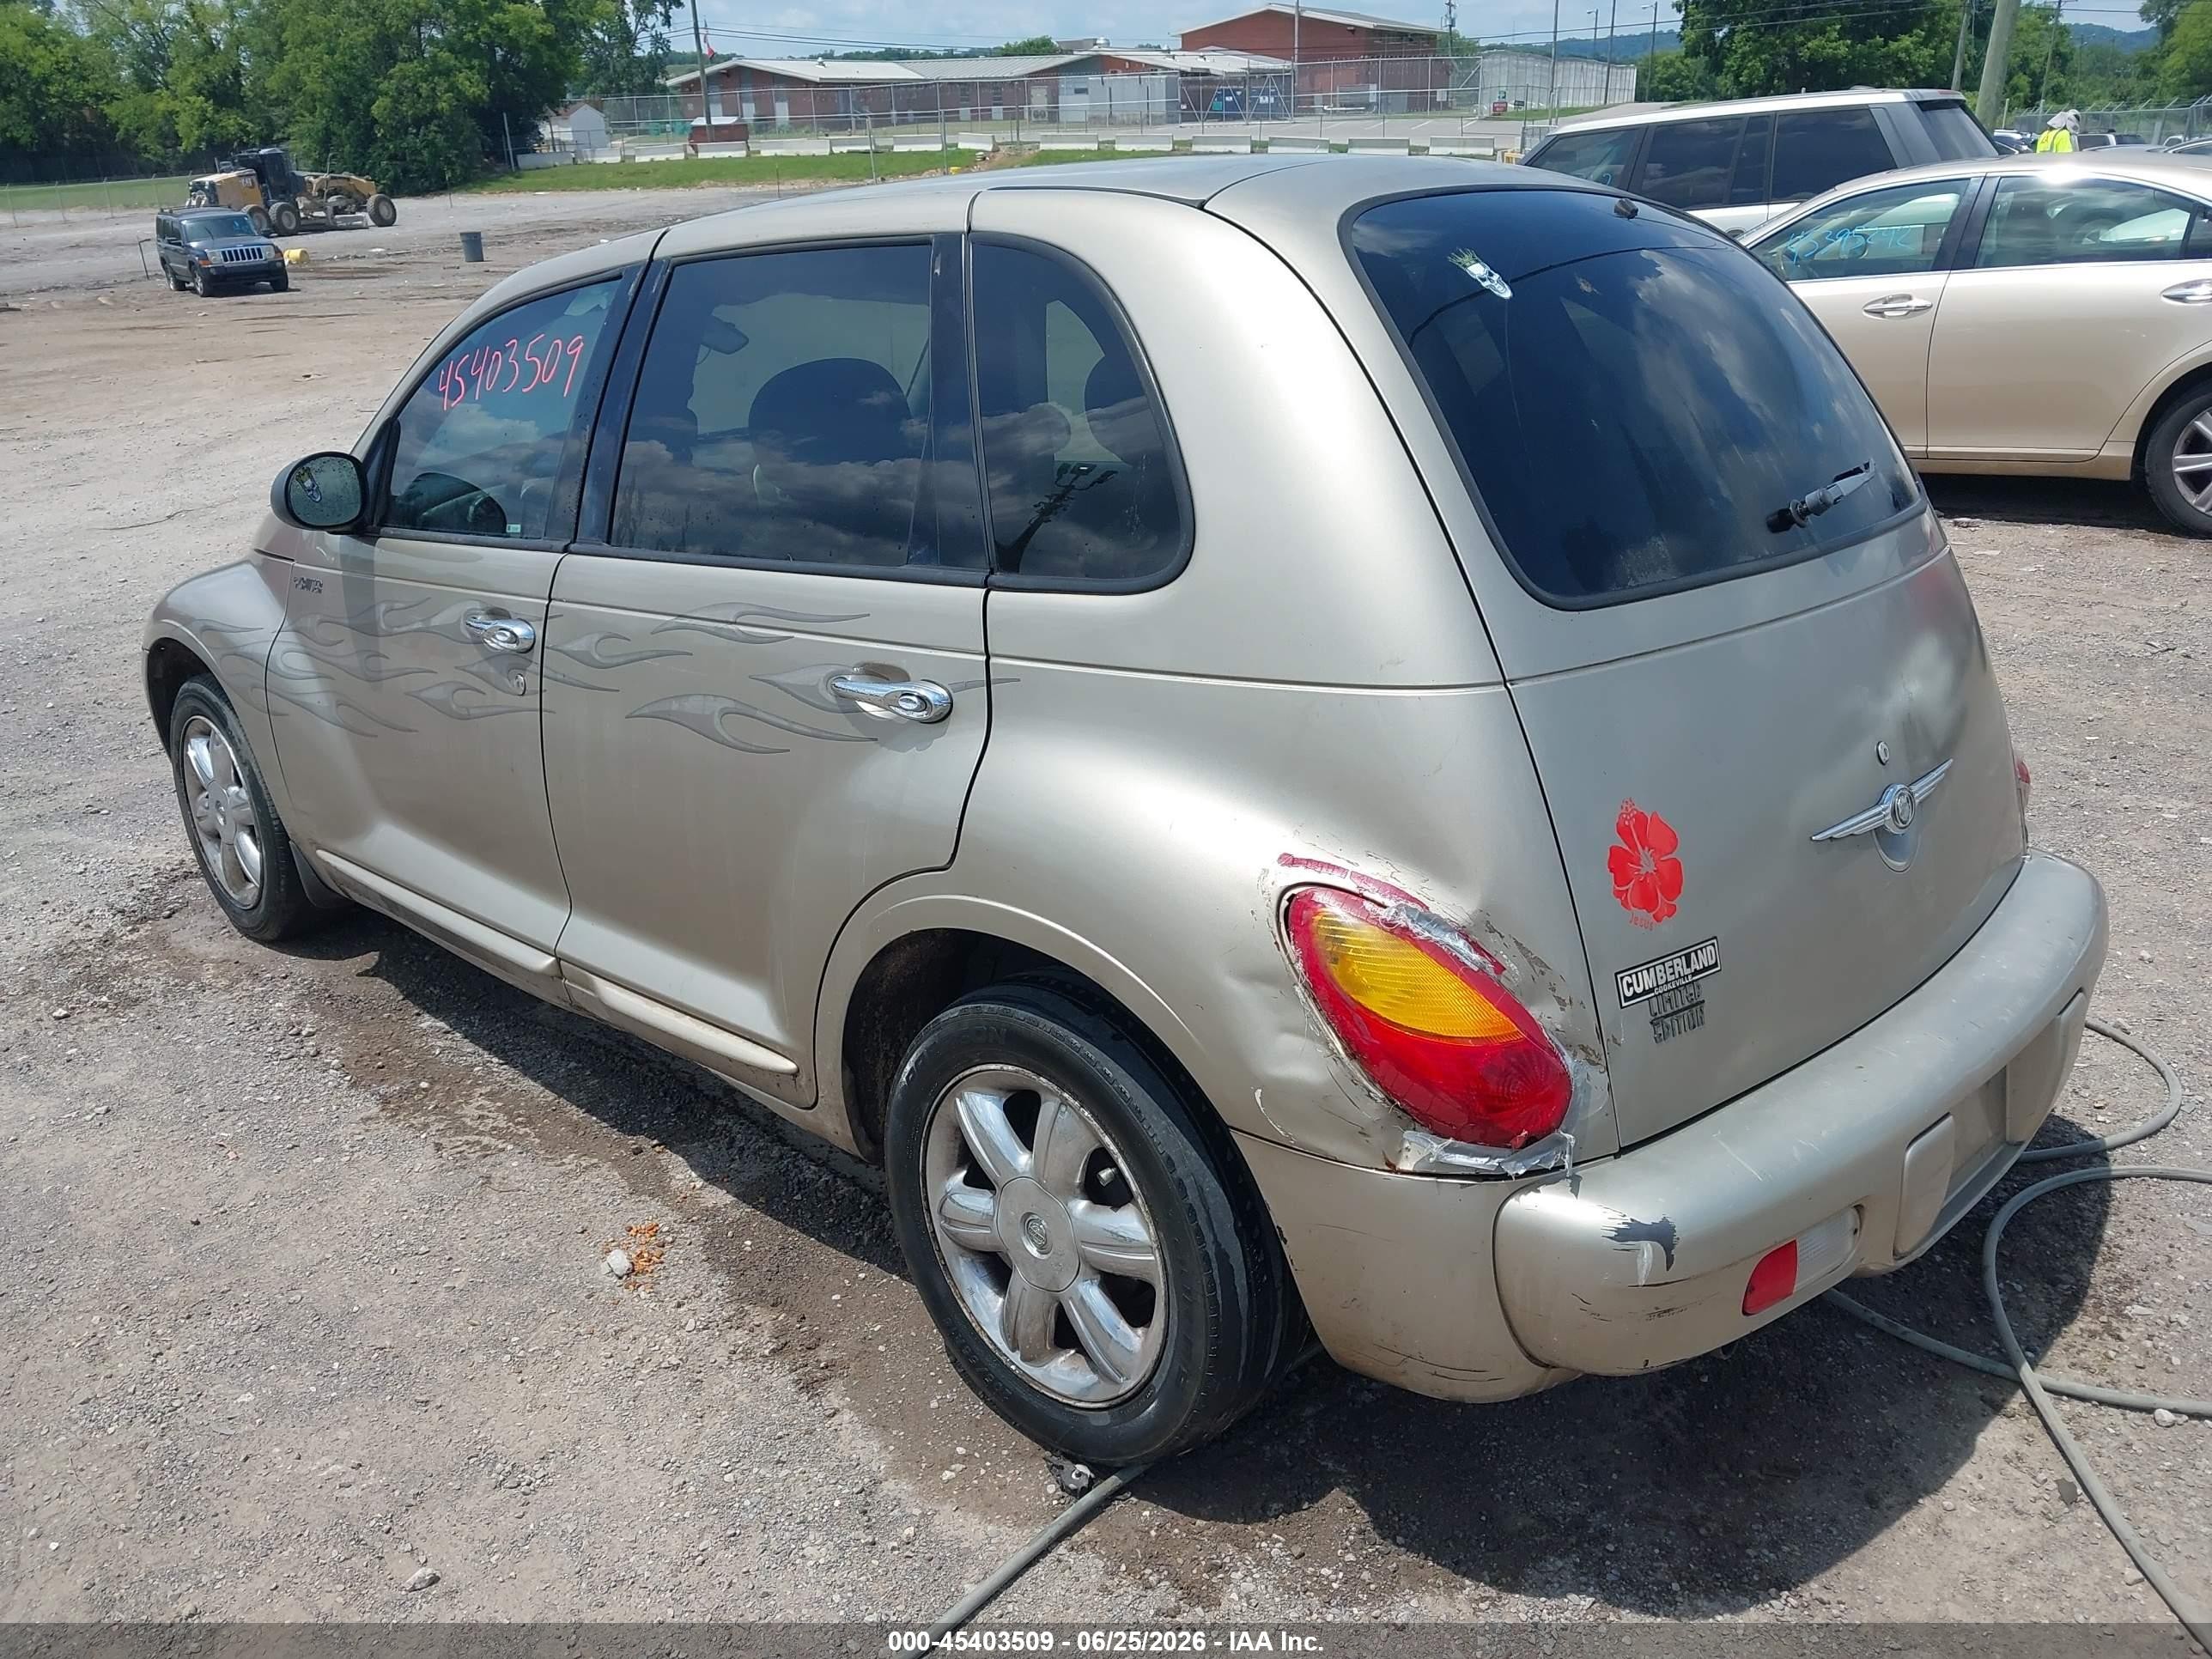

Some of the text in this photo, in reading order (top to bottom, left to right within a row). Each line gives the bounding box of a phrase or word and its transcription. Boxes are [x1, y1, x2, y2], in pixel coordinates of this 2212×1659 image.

[439, 333, 585, 410] 45403509
[1622, 945, 1717, 997] CUMBERLAND
[1654, 974, 1693, 995] COOKEVILLE
[1650, 1006, 1706, 1044] EDITION
